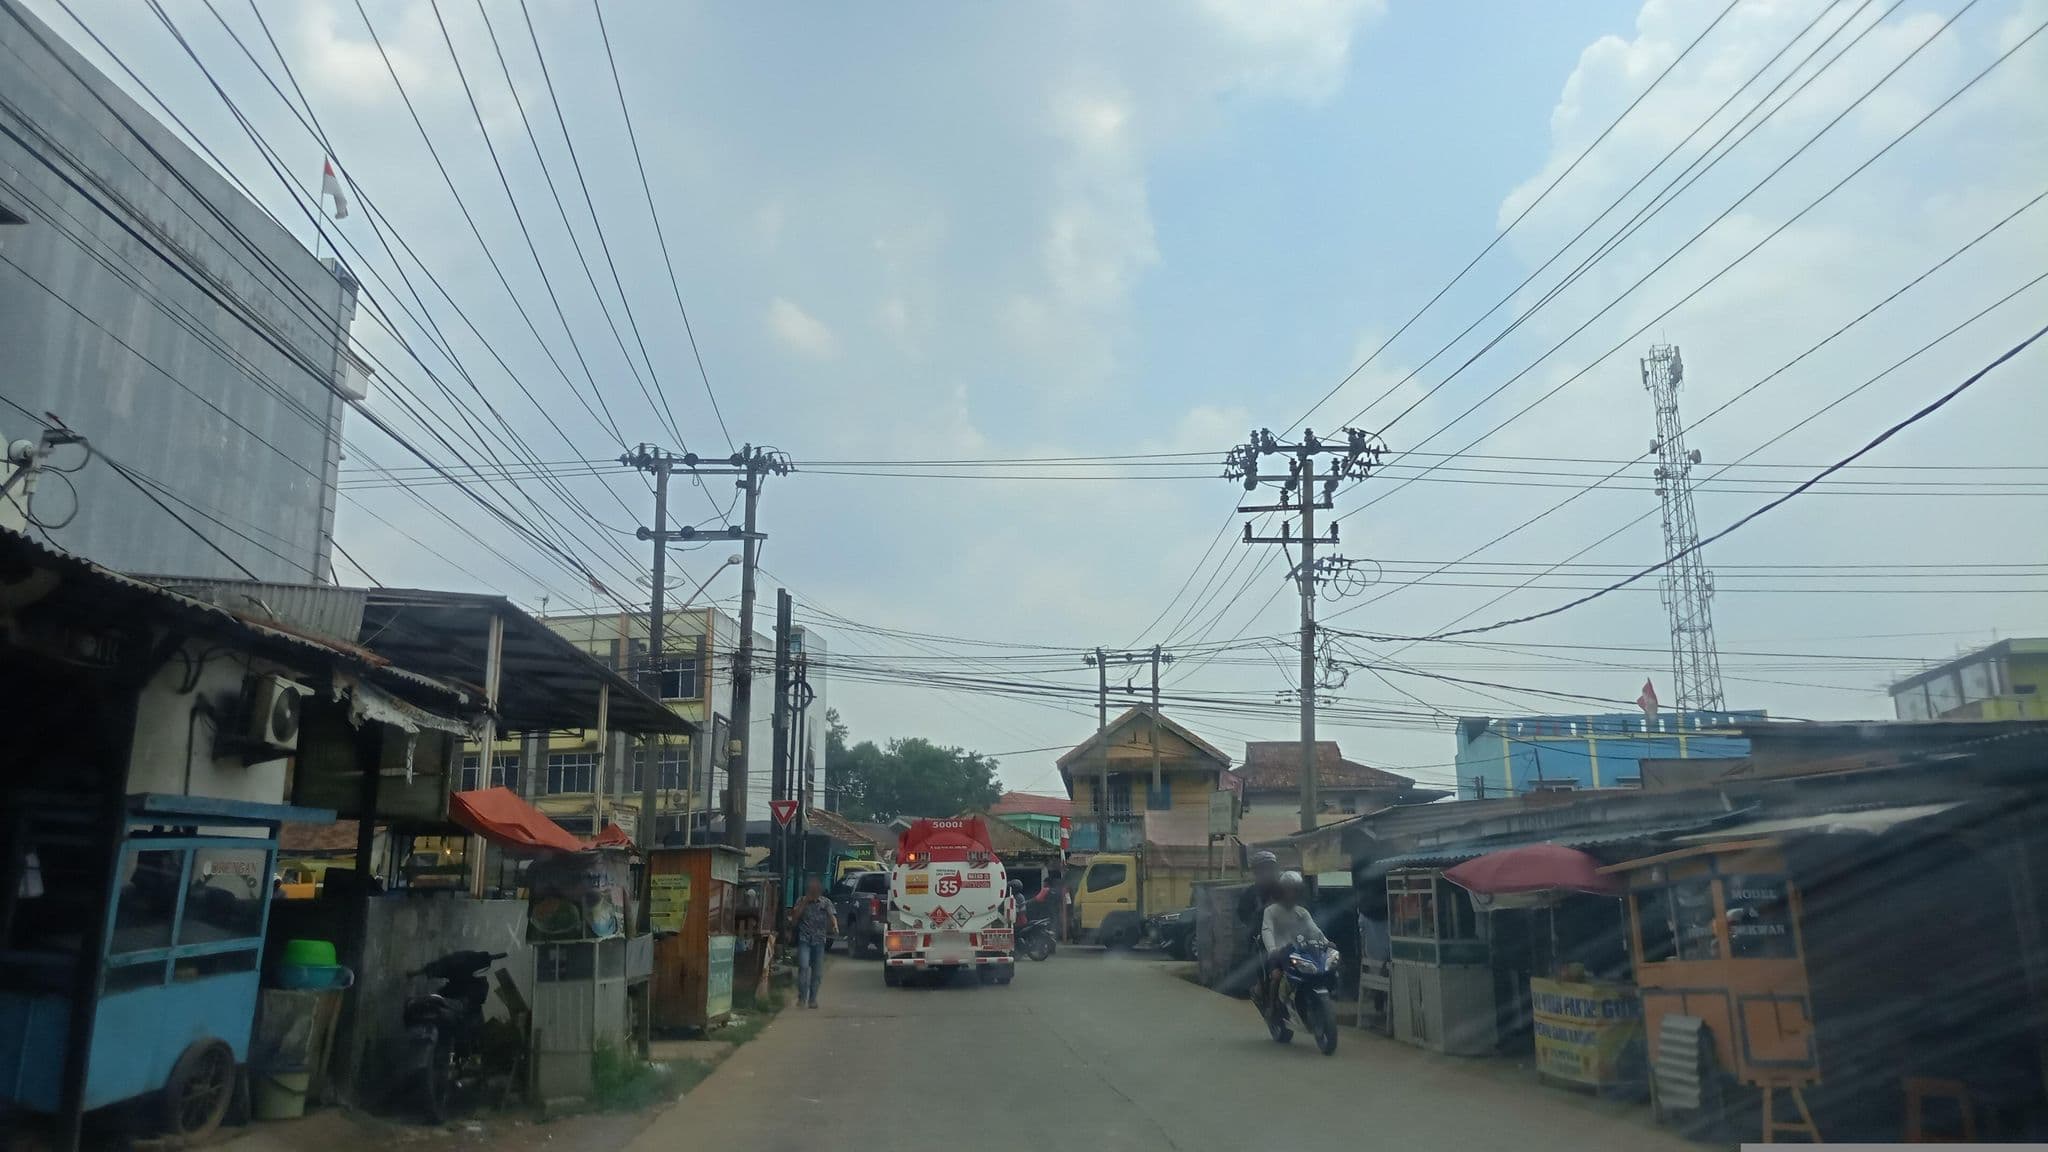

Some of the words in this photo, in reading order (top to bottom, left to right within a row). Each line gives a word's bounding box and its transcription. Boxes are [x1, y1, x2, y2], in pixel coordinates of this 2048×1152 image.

[204, 861, 257, 874] ORENGAN
[936, 880, 958, 894] 135
[1731, 889, 1777, 900] MODEL
